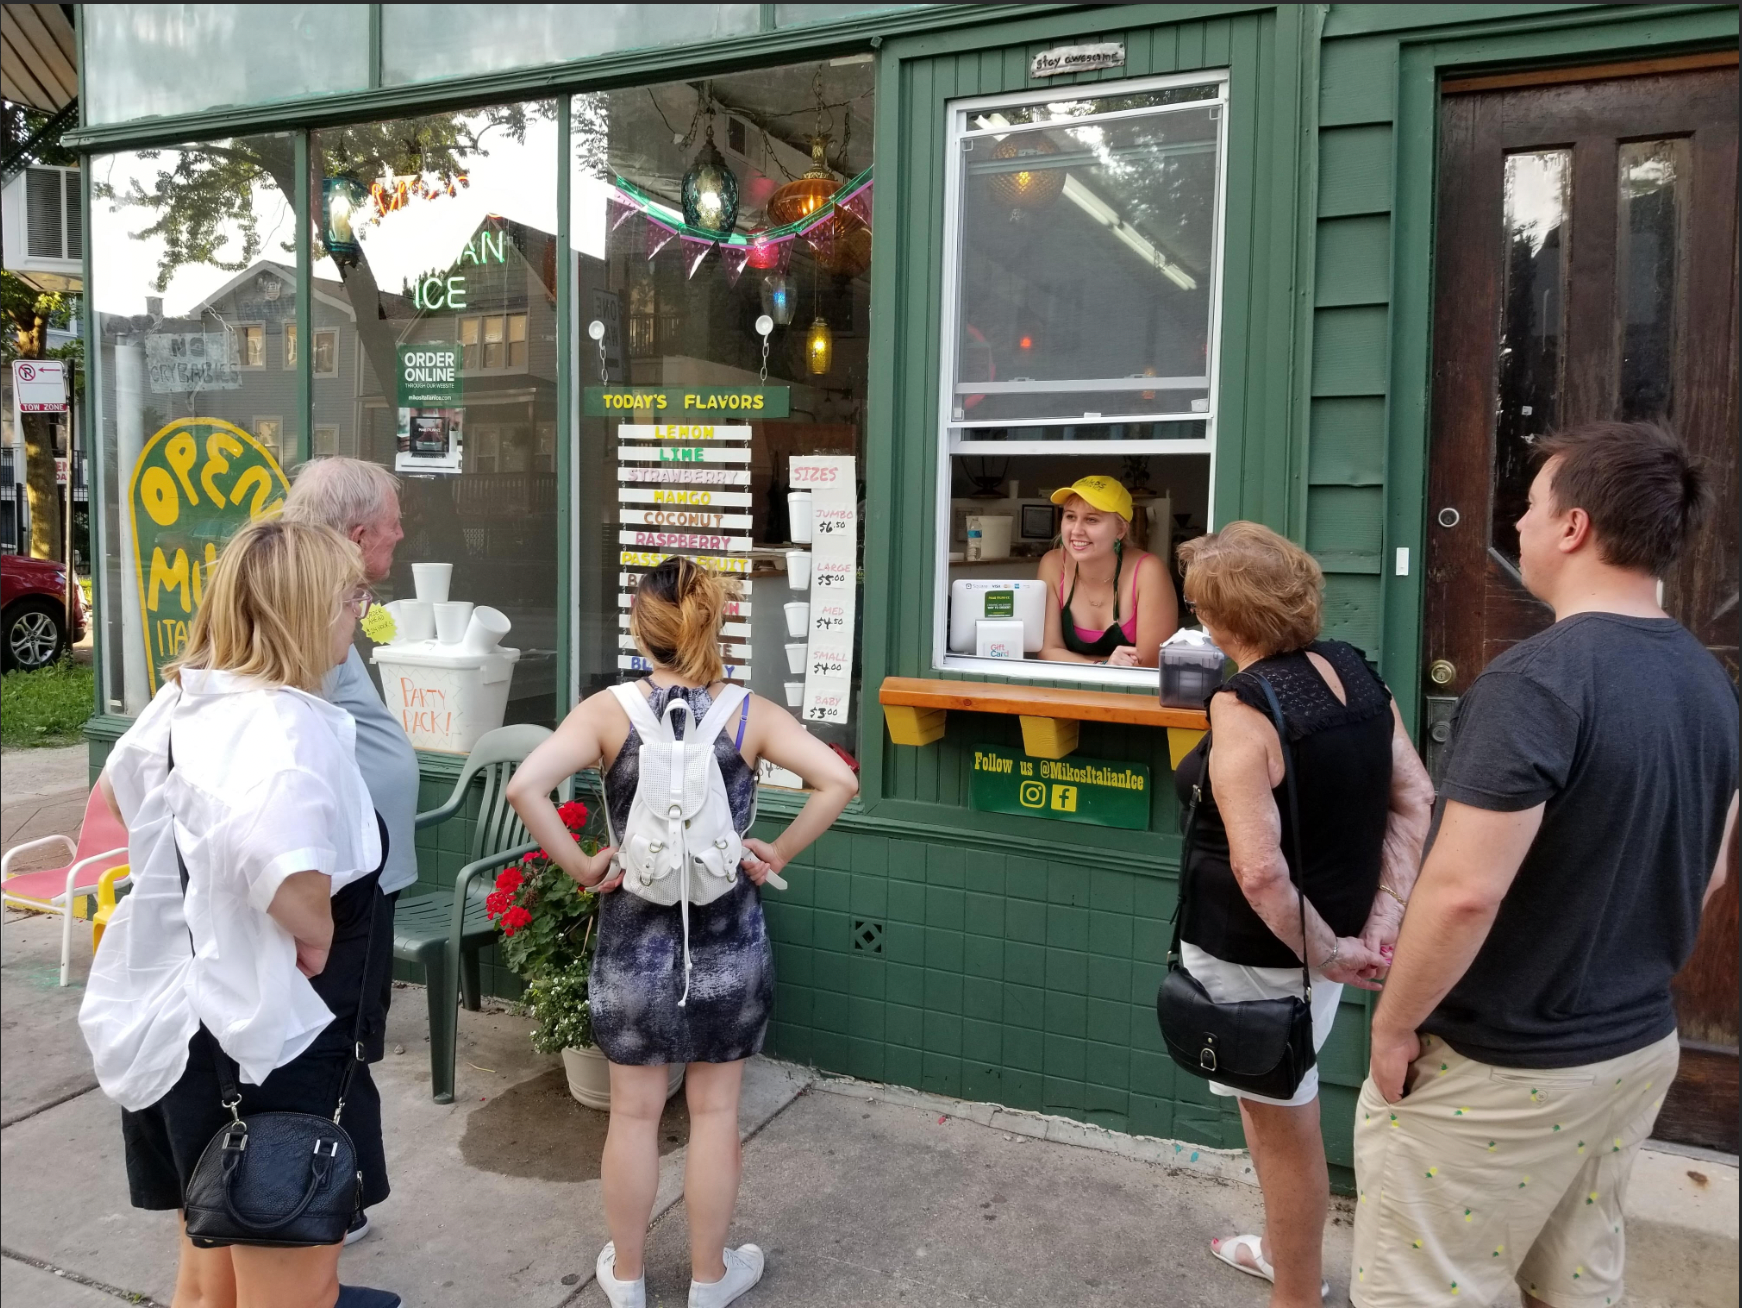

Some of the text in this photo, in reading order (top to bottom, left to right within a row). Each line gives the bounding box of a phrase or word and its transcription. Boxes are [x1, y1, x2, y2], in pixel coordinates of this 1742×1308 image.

[1036, 52, 1119, 69] stay awesome
[414, 277, 467, 309] ICE
[170, 336, 205, 357] NO
[404, 352, 454, 367] ORDER
[150, 362, 239, 384] CRYBABIES
[404, 368, 455, 381] ONLINE
[23, 403, 64, 411] TOW ZONE
[603, 393, 765, 410] TODAY'S FLAVORS
[655, 424, 714, 440] LEMON
[659, 447, 704, 462] LIME
[628, 468, 739, 484] STRAWBERRY
[794, 466, 839, 482] SIZES
[653, 490, 711, 505] MANGO
[643, 511, 724, 528] COCONUT
[815, 509, 853, 519] JUMBO
[819, 521, 846, 533] $6.50
[635, 532, 732, 550] RASPBERRY
[816, 563, 852, 573] LARGE
[818, 574, 846, 586] $5.00
[822, 606, 845, 616] MED
[816, 617, 844, 630] $4.50
[813, 651, 848, 662] SMALL
[990, 649, 1010, 658] Card
[813, 662, 842, 675] $4.00
[814, 695, 842, 706] BABY
[809, 706, 839, 719] $3.00
[402, 709, 452, 736] PACK!
[974, 751, 1144, 791] Follow us @MikosItalianIce
